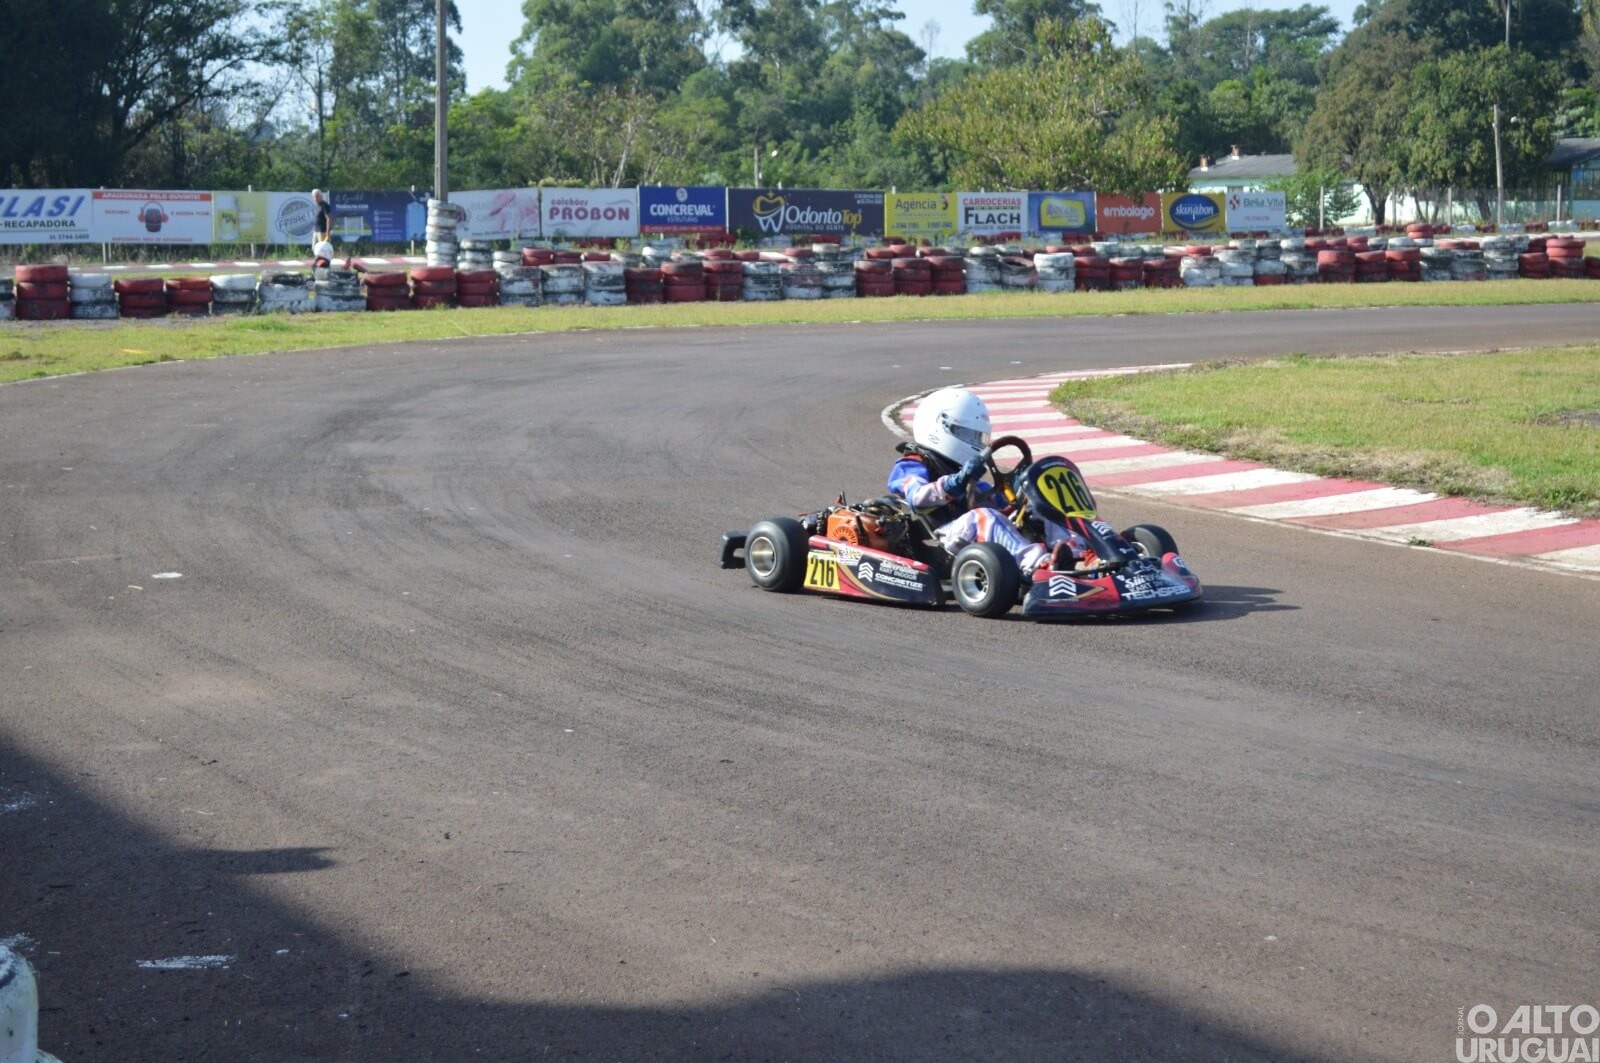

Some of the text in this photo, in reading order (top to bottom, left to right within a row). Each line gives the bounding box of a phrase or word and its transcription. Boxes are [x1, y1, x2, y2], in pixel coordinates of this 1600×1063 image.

[650, 204, 714, 216] CONCREVAL
[962, 198, 1021, 206] CARROCERIAS
[549, 207, 630, 221] PROBON
[964, 206, 1021, 225] FLACH
[1044, 470, 1096, 515] 216
[809, 556, 835, 588] 216
